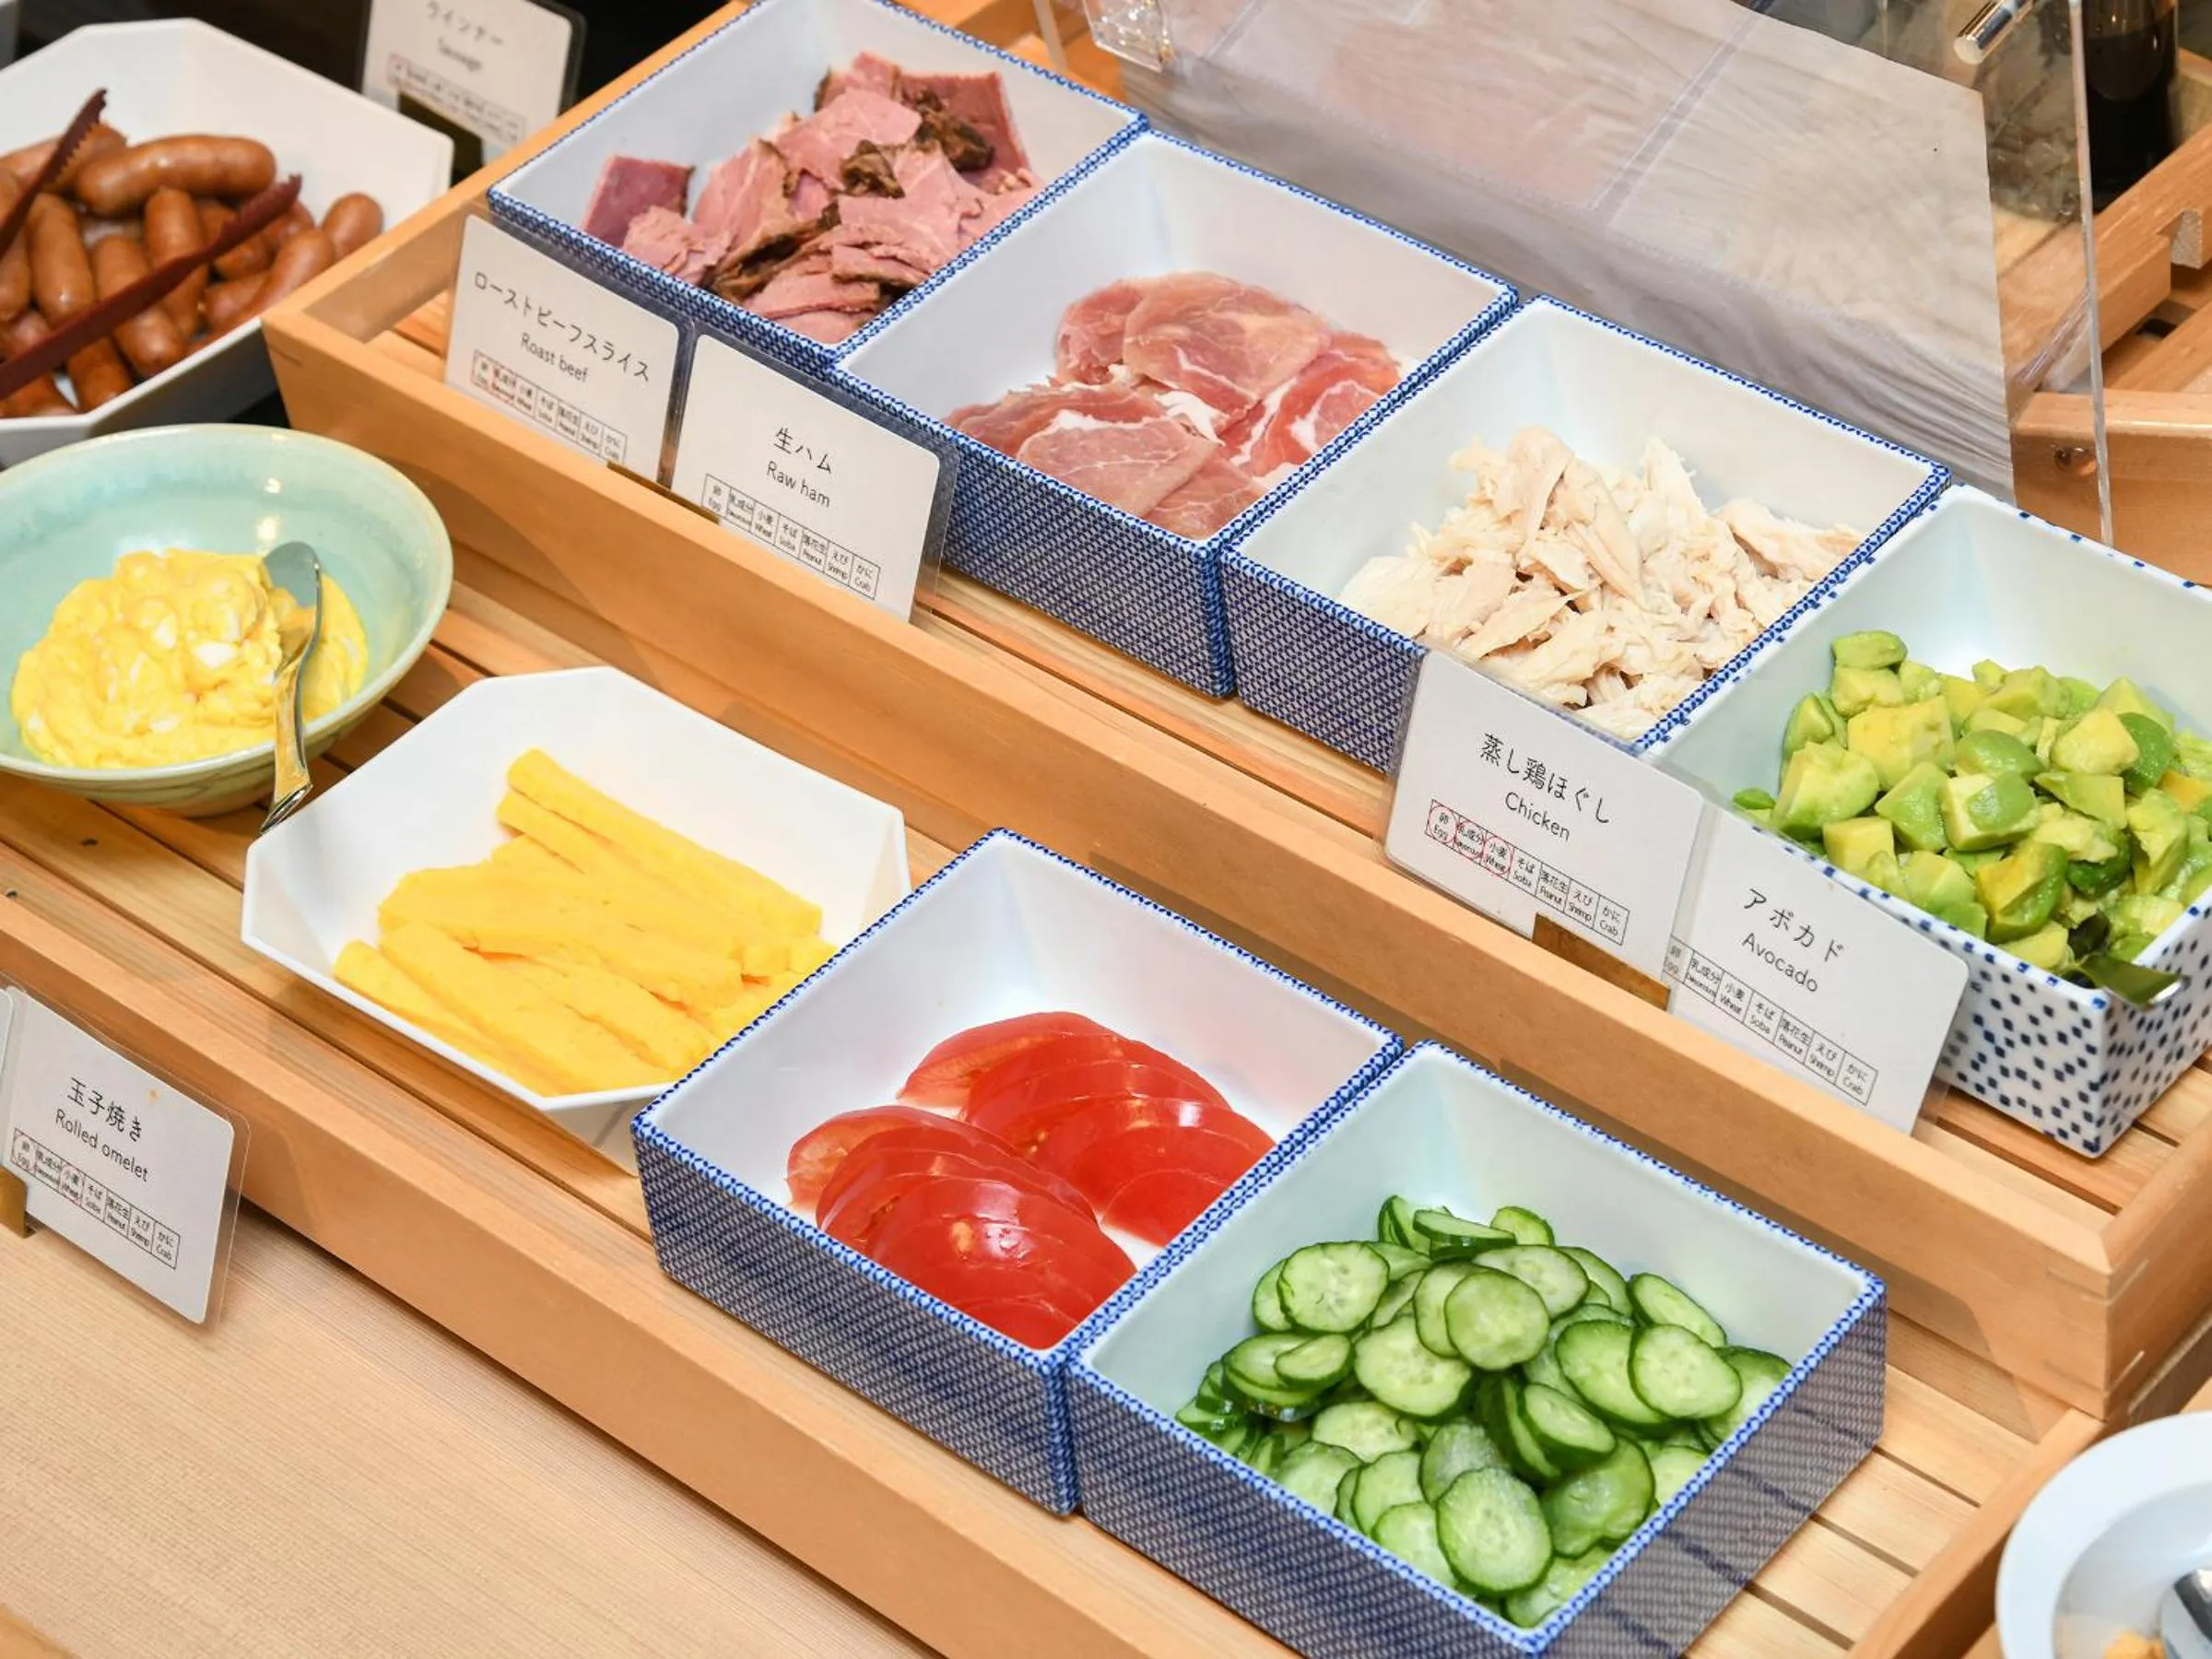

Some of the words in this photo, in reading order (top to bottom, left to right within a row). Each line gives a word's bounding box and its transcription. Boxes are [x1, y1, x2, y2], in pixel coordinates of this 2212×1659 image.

[475, 272, 649, 382] ローストビーフスライス
[521, 332, 555, 366] Roast
[559, 354, 590, 382] beef
[773, 427, 832, 474] 生ハム
[767, 461, 796, 489] Raw
[801, 478, 830, 508] ham
[1479, 732, 1610, 824] 蒸し鶏ほぐし
[1505, 792, 1571, 841] Chicken
[1512, 870, 1532, 887] Soba
[1599, 920, 1618, 937] Crab
[1517, 858, 1535, 874] そば
[1540, 869, 1568, 894] 落花生
[1573, 889, 1593, 906] えび
[1602, 906, 1621, 924] かに
[1744, 888, 1845, 962] アボカド
[1741, 933, 1818, 993] Avocado
[1756, 1002, 1774, 1021] そば
[1816, 1042, 1839, 1062] えび
[1846, 1064, 1868, 1083] かに
[66, 1077, 143, 1142] 玉子焼き
[1842, 1077, 1864, 1095] Crab
[55, 1108, 99, 1150] Rolled
[101, 1143, 149, 1182] omelet
